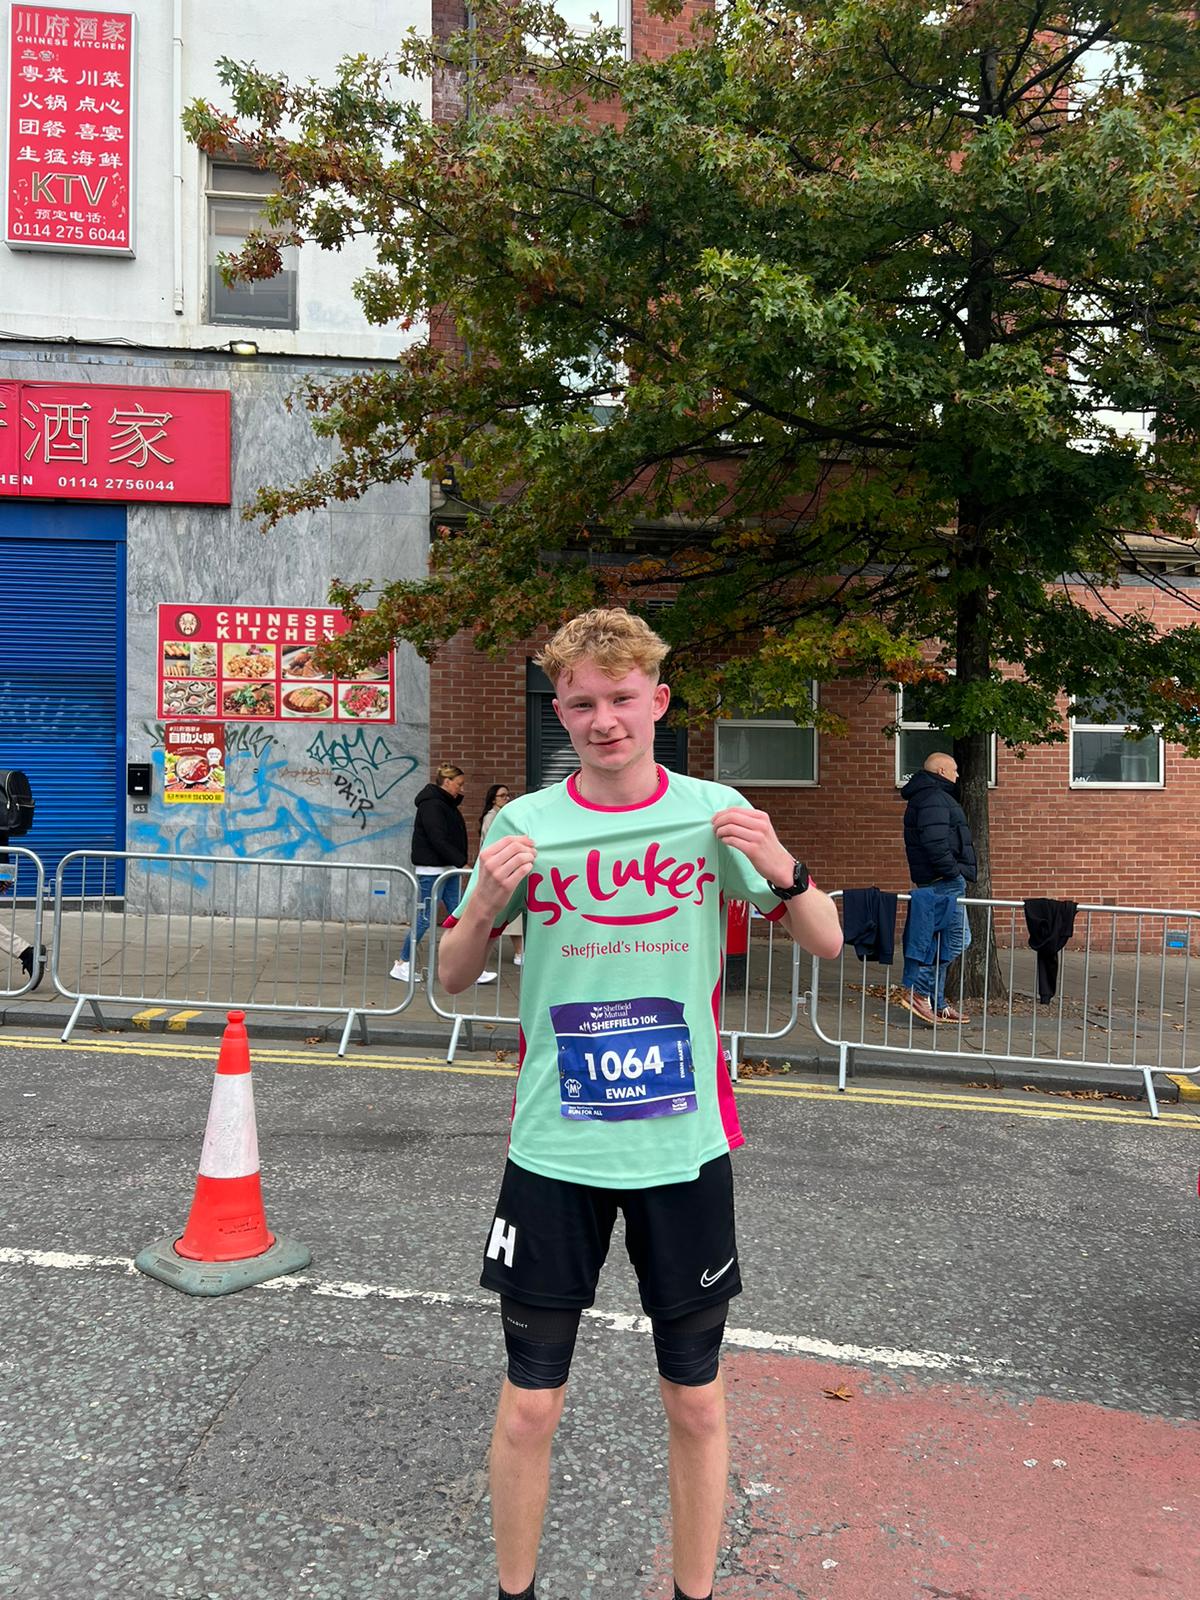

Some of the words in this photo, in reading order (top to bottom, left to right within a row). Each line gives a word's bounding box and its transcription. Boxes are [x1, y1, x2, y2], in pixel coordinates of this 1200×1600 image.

[16, 12, 127, 43] 川府酒家
[17, 36, 69, 47] CHINESE
[74, 40, 126, 51] KITCHEN
[18, 65, 69, 84] 粤菜
[76, 70, 125, 88] 川菜
[19, 92, 68, 112] 火锅
[75, 96, 124, 115] 点心
[19, 119, 67, 138] 团餐
[75, 123, 124, 143] 喜宴
[31, 172, 108, 206] KTV
[13, 222, 52, 238] 0114
[56, 225, 84, 240] 275
[88, 227, 127, 242] 6044
[0, 400, 175, 468] 酒家
[58, 477, 99, 489] 0114
[105, 479, 175, 491] 2756044
[216, 611, 335, 628] CHINESE
[216, 626, 336, 643] KITCHEN
[586, 842, 716, 906] Luke's
[561, 939, 631, 959] Sheffield's
[635, 939, 689, 954] Hospice
[603, 1003, 632, 1013] Sheffield
[604, 1010, 629, 1019] Mutual
[591, 1017, 640, 1031] SHEFFIELD
[640, 1014, 658, 1025] 10K
[584, 1045, 665, 1081] 1064
[605, 1084, 647, 1100] EWAN
[486, 1216, 517, 1268] H
